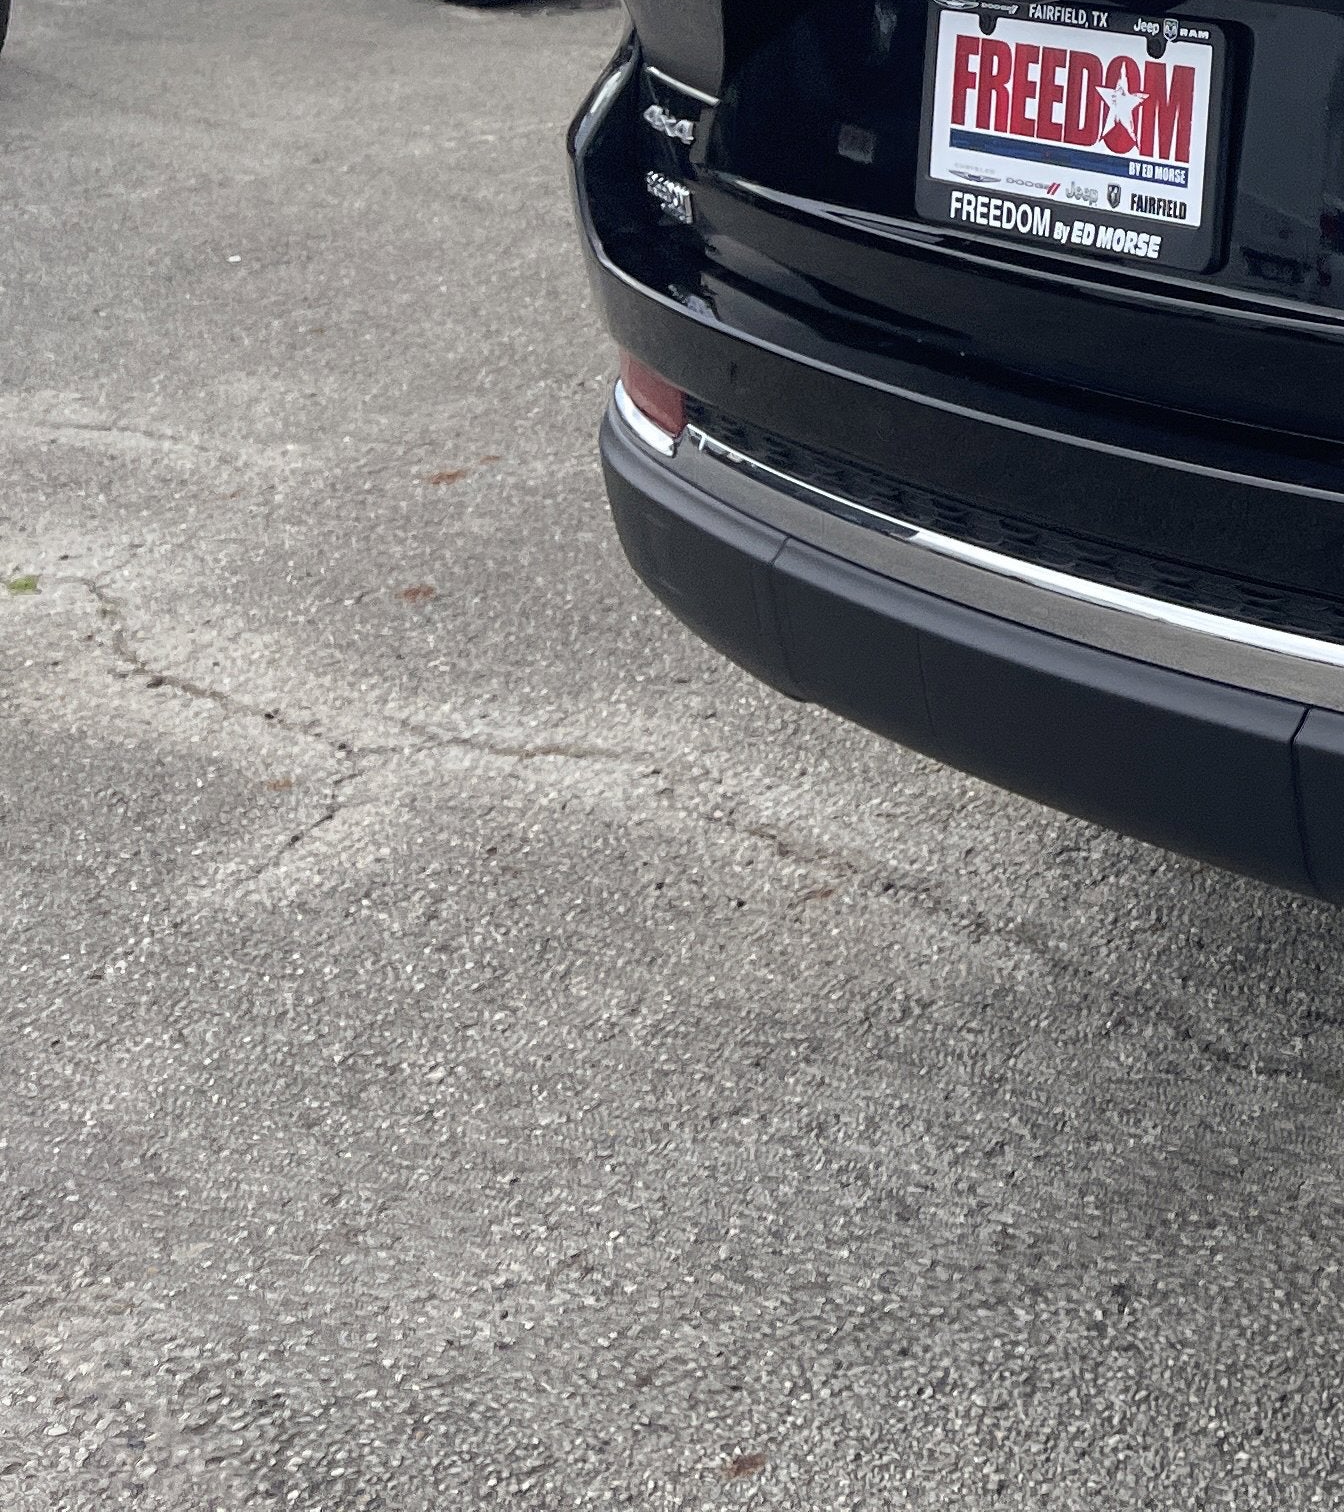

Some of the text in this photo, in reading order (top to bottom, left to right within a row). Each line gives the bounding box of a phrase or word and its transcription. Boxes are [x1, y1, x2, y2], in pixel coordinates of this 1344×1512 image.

[1028, 3, 1109, 28] FAIRFIELD, TX
[1133, 17, 1160, 36] Jeep
[950, 34, 1196, 164] FREEDOM
[1128, 161, 1186, 185] BY ED MORSE
[1065, 181, 1099, 206] Jeep
[1130, 193, 1188, 220] FAIRFIELD
[950, 191, 1051, 238] FREEDOM
[1071, 220, 1096, 246] ED
[1096, 225, 1162, 259] MORSE
